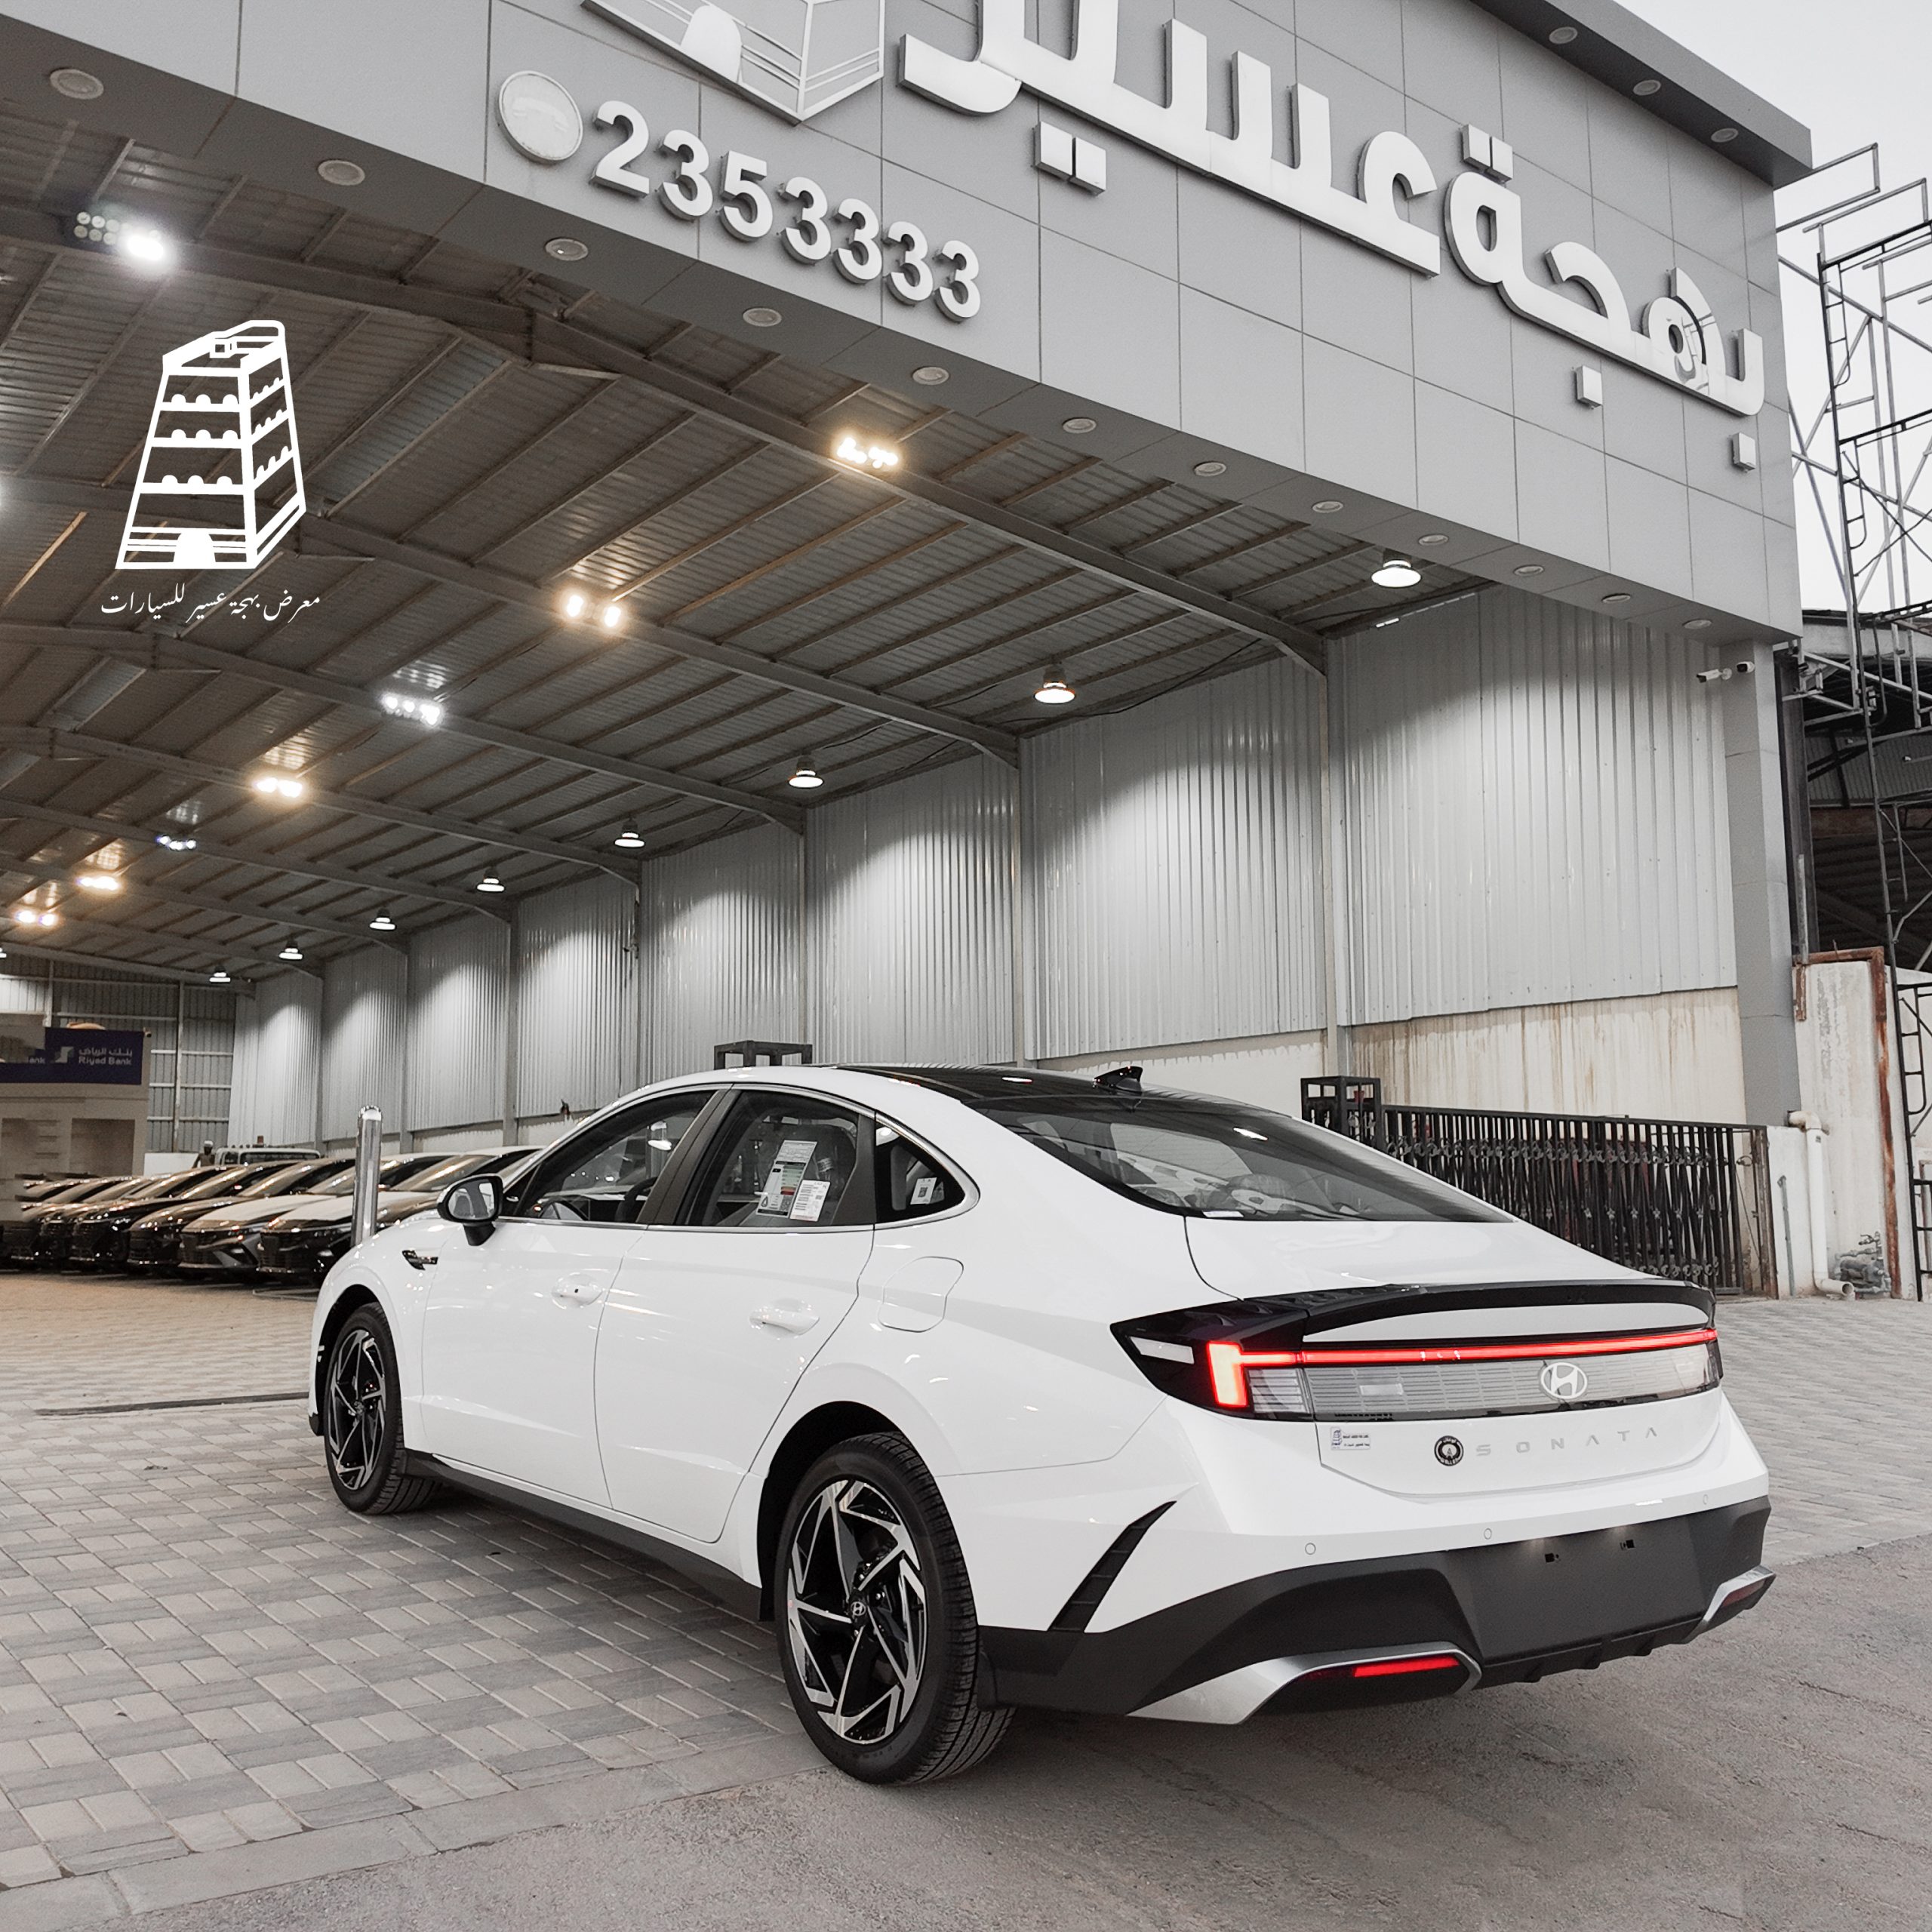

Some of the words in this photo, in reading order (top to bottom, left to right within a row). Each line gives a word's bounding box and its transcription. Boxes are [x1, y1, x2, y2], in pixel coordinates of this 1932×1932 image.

[589, 100, 980, 323] 2353333
[1444, 123, 1765, 472] بهجة
[78, 1057, 106, 1066] Riyad
[108, 1057, 132, 1065] Bank
[1475, 1426, 1658, 1457] SONATA
